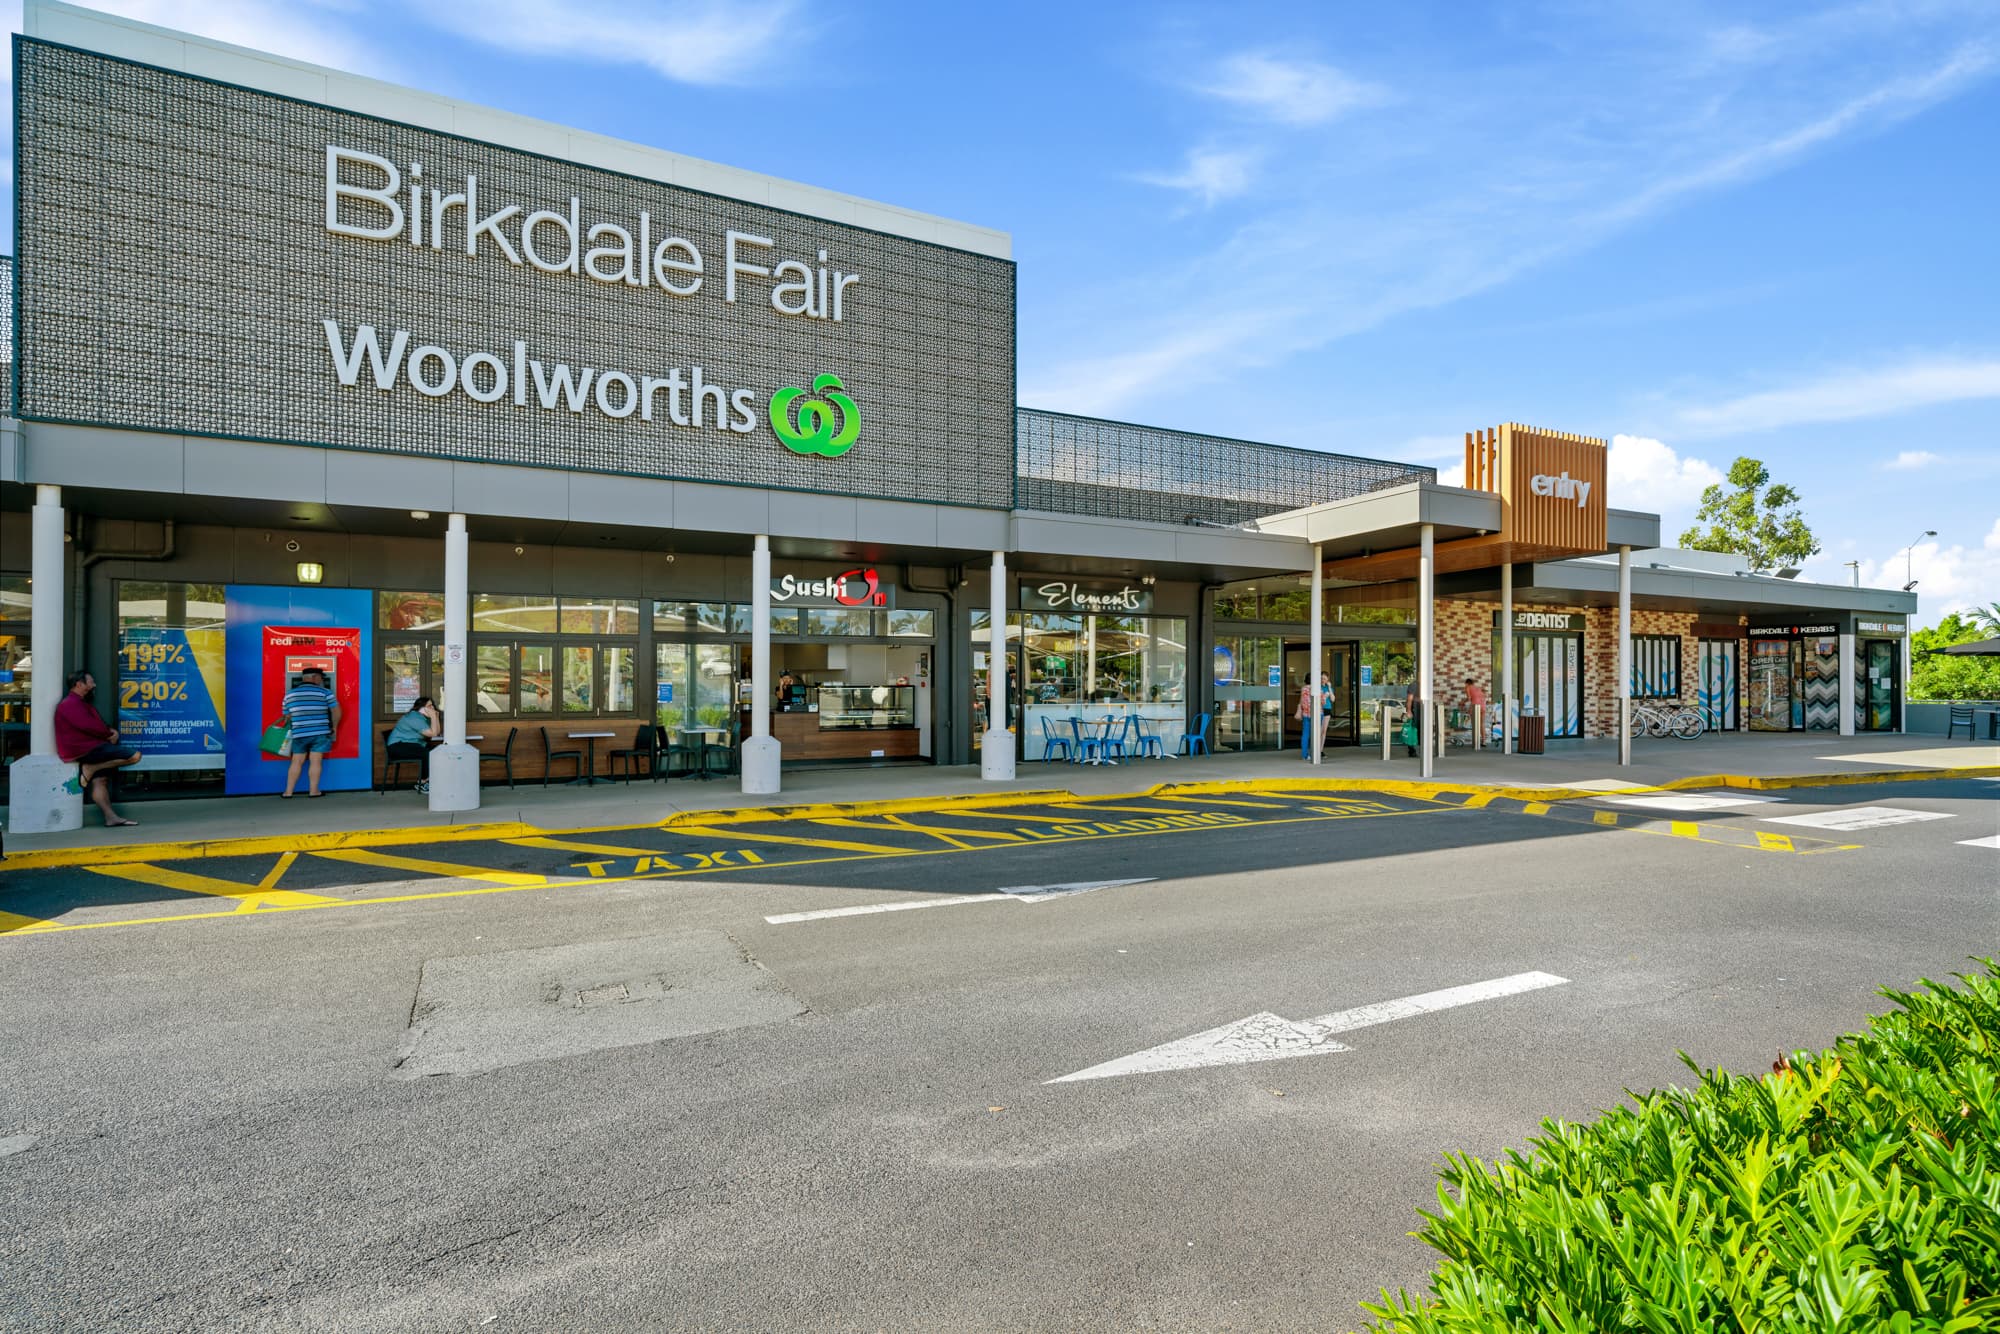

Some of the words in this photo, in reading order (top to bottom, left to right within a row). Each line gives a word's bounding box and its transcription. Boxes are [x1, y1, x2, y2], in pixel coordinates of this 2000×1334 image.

[326, 144, 704, 297] Birkdale
[725, 230, 860, 323] Fair
[322, 319, 758, 434] Woolworths
[1530, 471, 1592, 508] entry
[770, 574, 848, 601] Sushi
[1038, 582, 1140, 609] Elements
[1526, 613, 1571, 629] DENTIST
[1750, 627, 1790, 635] BIRKDALE
[1800, 625, 1836, 633] KEBABS
[121, 681, 188, 708] 2.90%
[121, 720, 148, 728] REDUCE
[149, 720, 169, 728] YOUR
[169, 720, 214, 728] REPAYMENTS
[144, 727, 164, 735] YOUR
[164, 727, 192, 735] BUDGET
[1015, 811, 1255, 840] LOADING
[1304, 802, 1404, 816] BAY
[570, 849, 765, 877] TAXI
